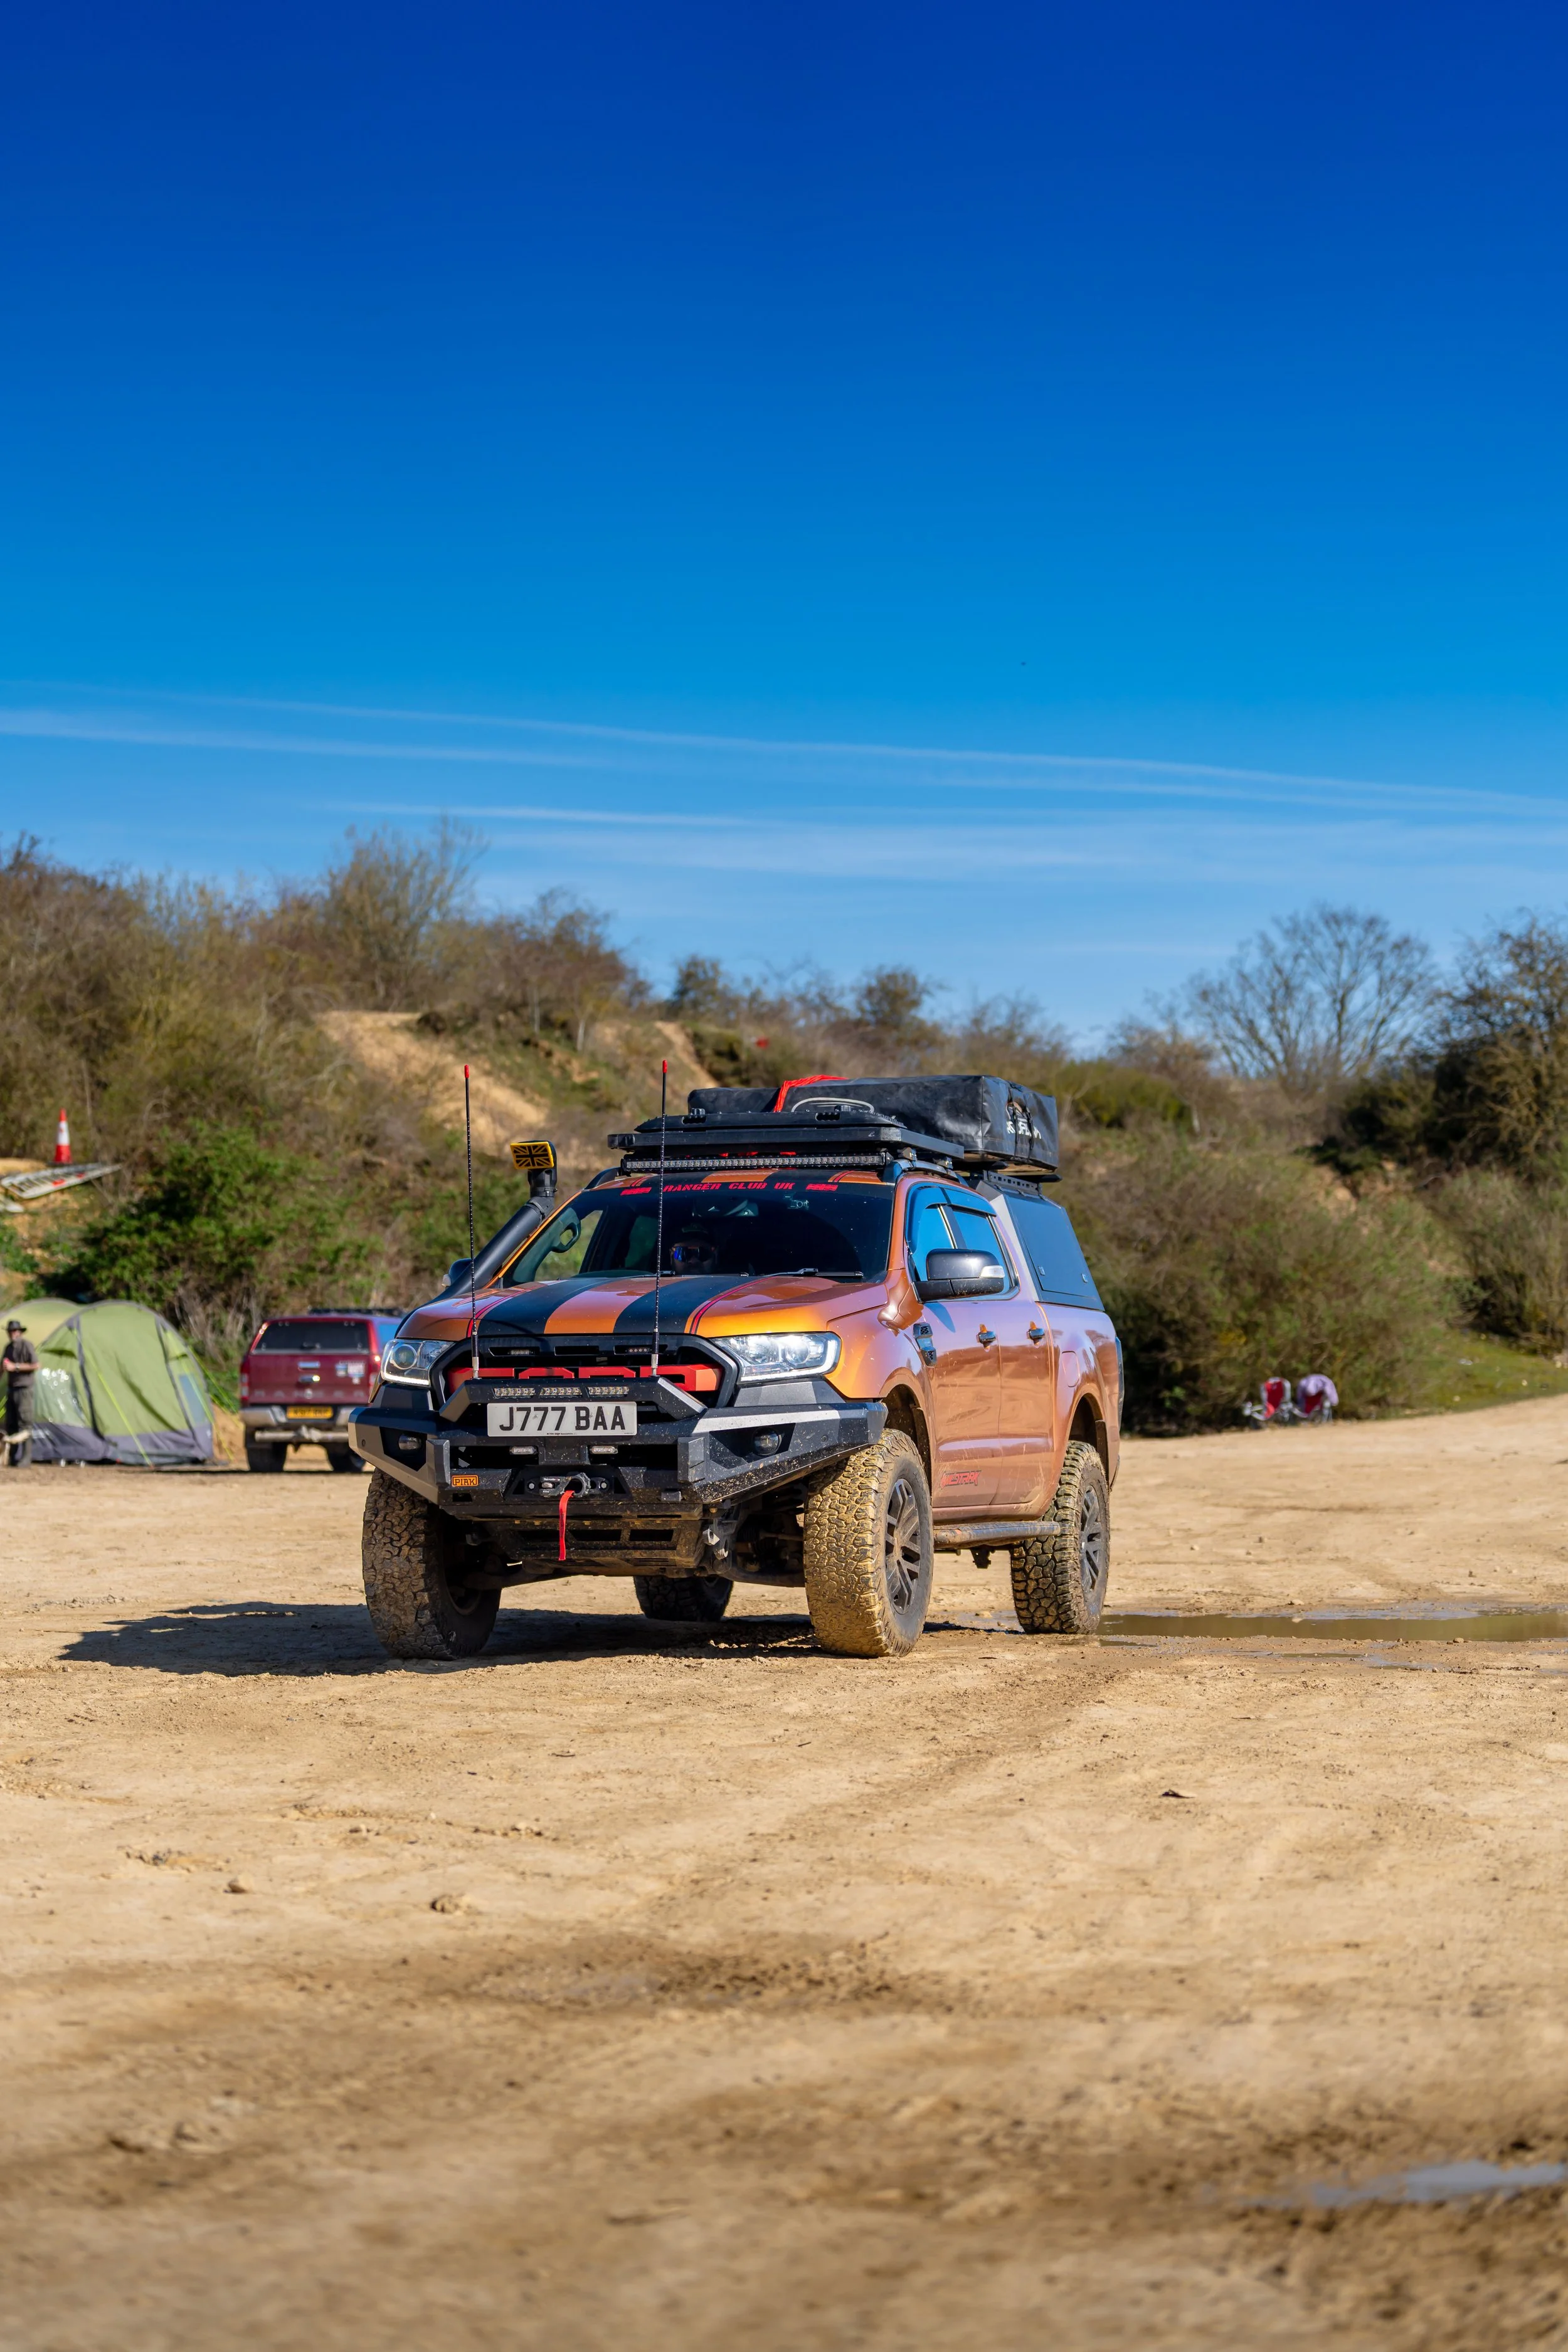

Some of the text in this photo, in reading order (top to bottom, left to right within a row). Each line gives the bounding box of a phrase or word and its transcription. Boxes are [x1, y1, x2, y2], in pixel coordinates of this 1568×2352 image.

[663, 1183, 722, 1192] RANGER
[499, 1406, 626, 1431] J777 BAA
[454, 1478, 475, 1486] PIAK
